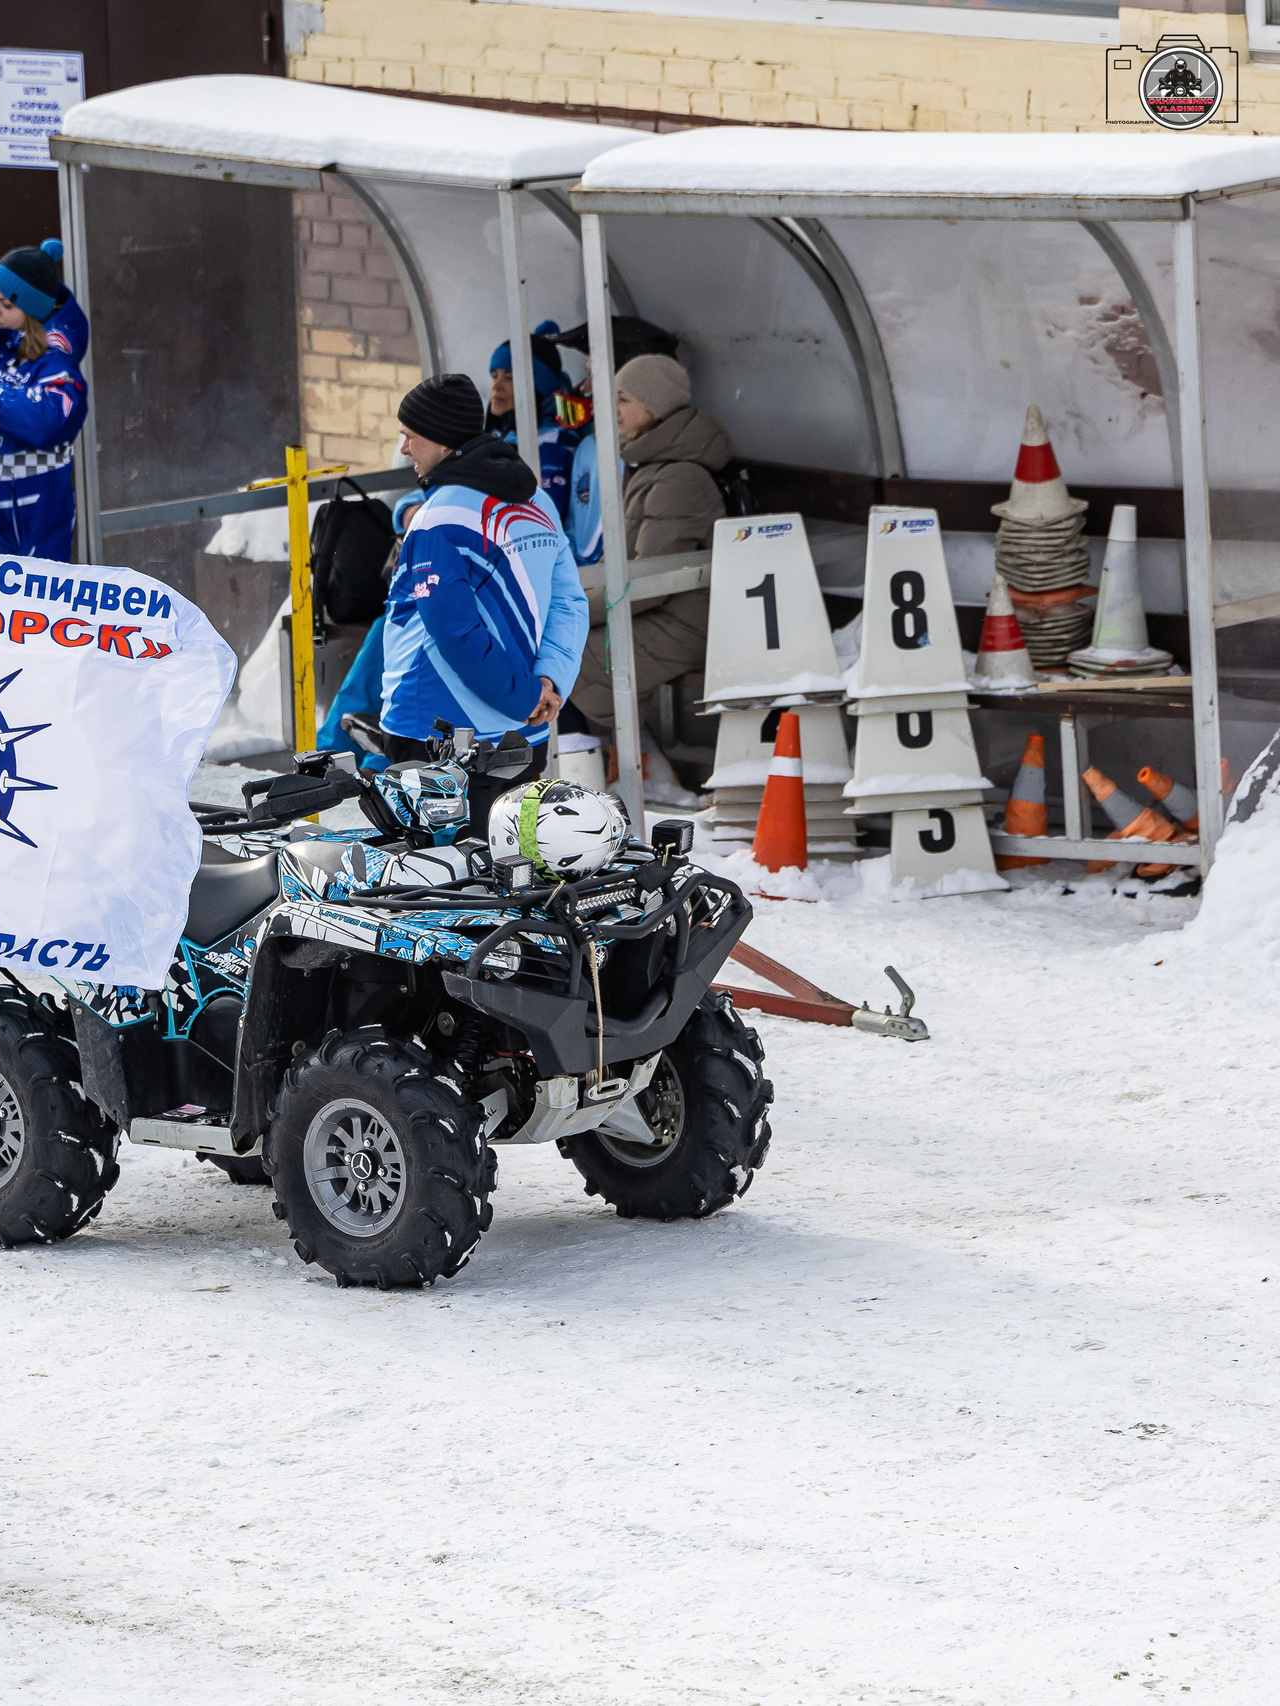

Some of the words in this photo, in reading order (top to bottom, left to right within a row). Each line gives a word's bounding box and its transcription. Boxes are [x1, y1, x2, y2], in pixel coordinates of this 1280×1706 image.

[745, 573, 780, 651] 1
[890, 570, 928, 651] 8
[389, 790, 413, 823] YAMAHA
[319, 909, 361, 926] LIMITED
[360, 921, 407, 940] EDITION
